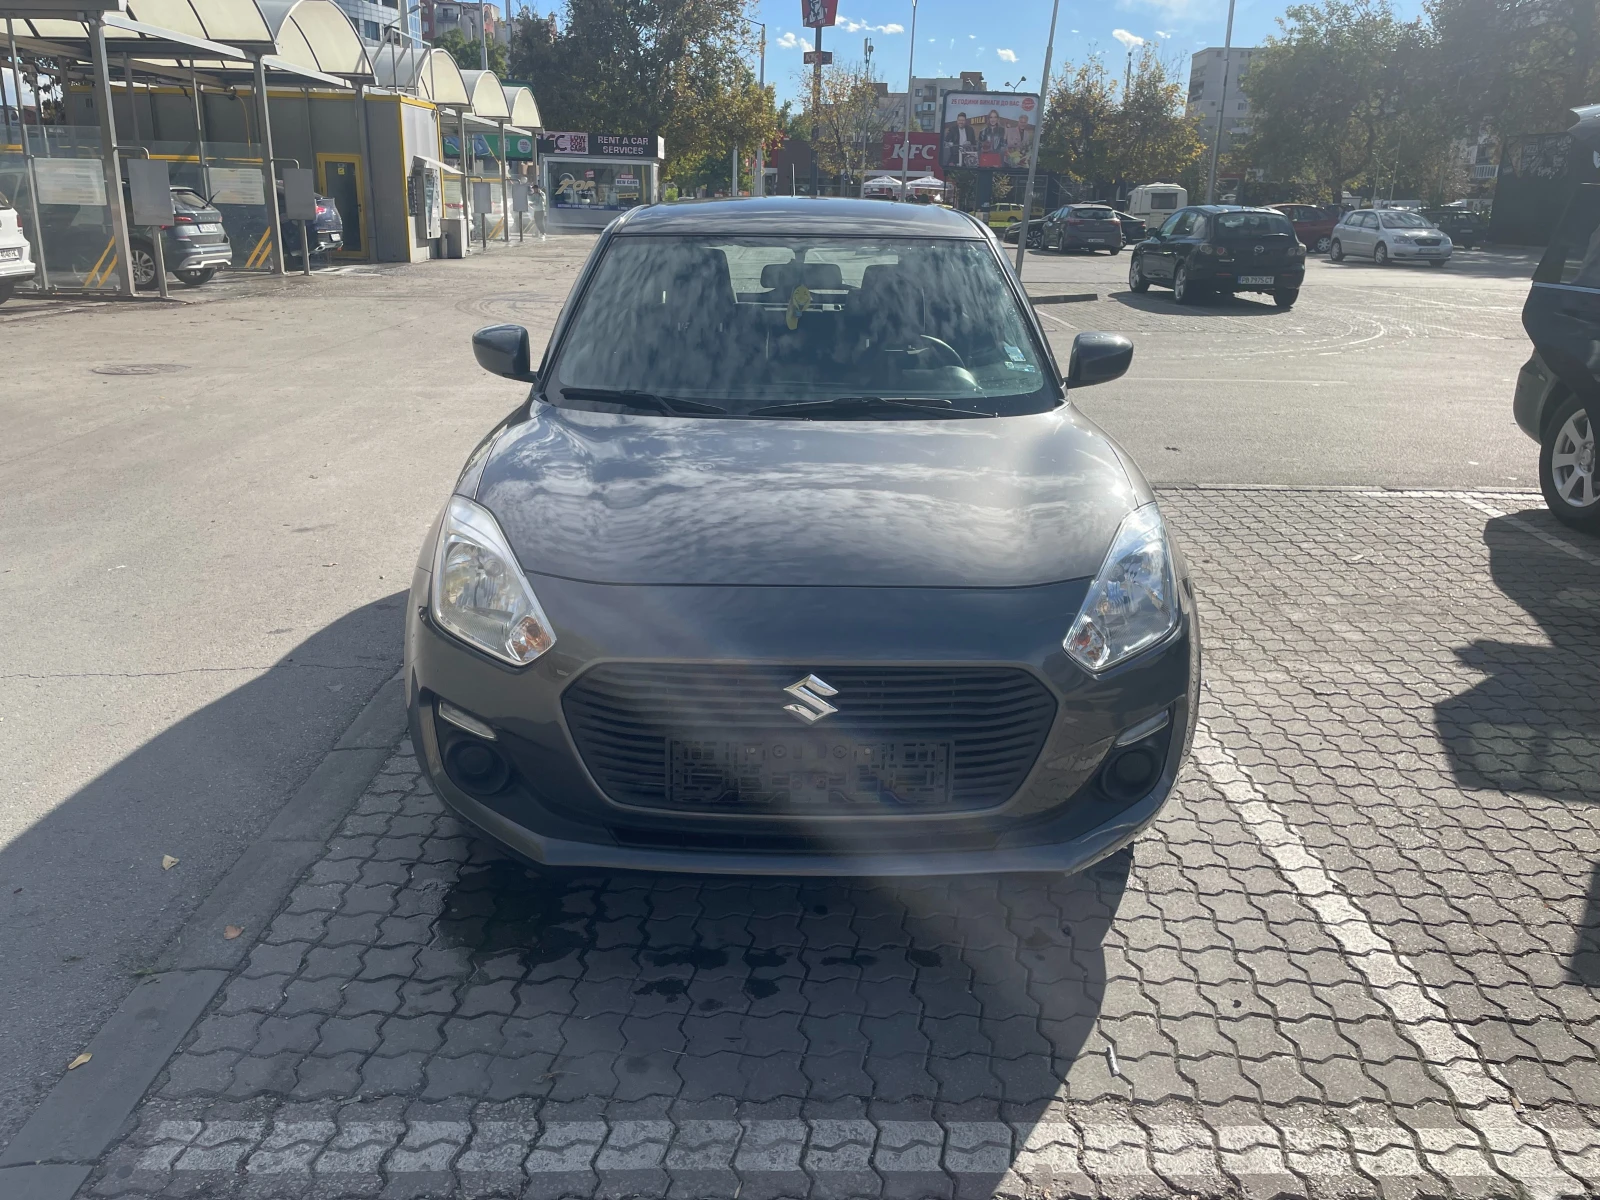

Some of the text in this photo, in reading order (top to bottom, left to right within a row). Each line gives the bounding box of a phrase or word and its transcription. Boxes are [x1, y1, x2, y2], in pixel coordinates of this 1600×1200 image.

[597, 136, 649, 145] RENT A CAR
[603, 145, 644, 155] SERVICES
[891, 144, 936, 159] KFC
[555, 180, 596, 195] TOP
